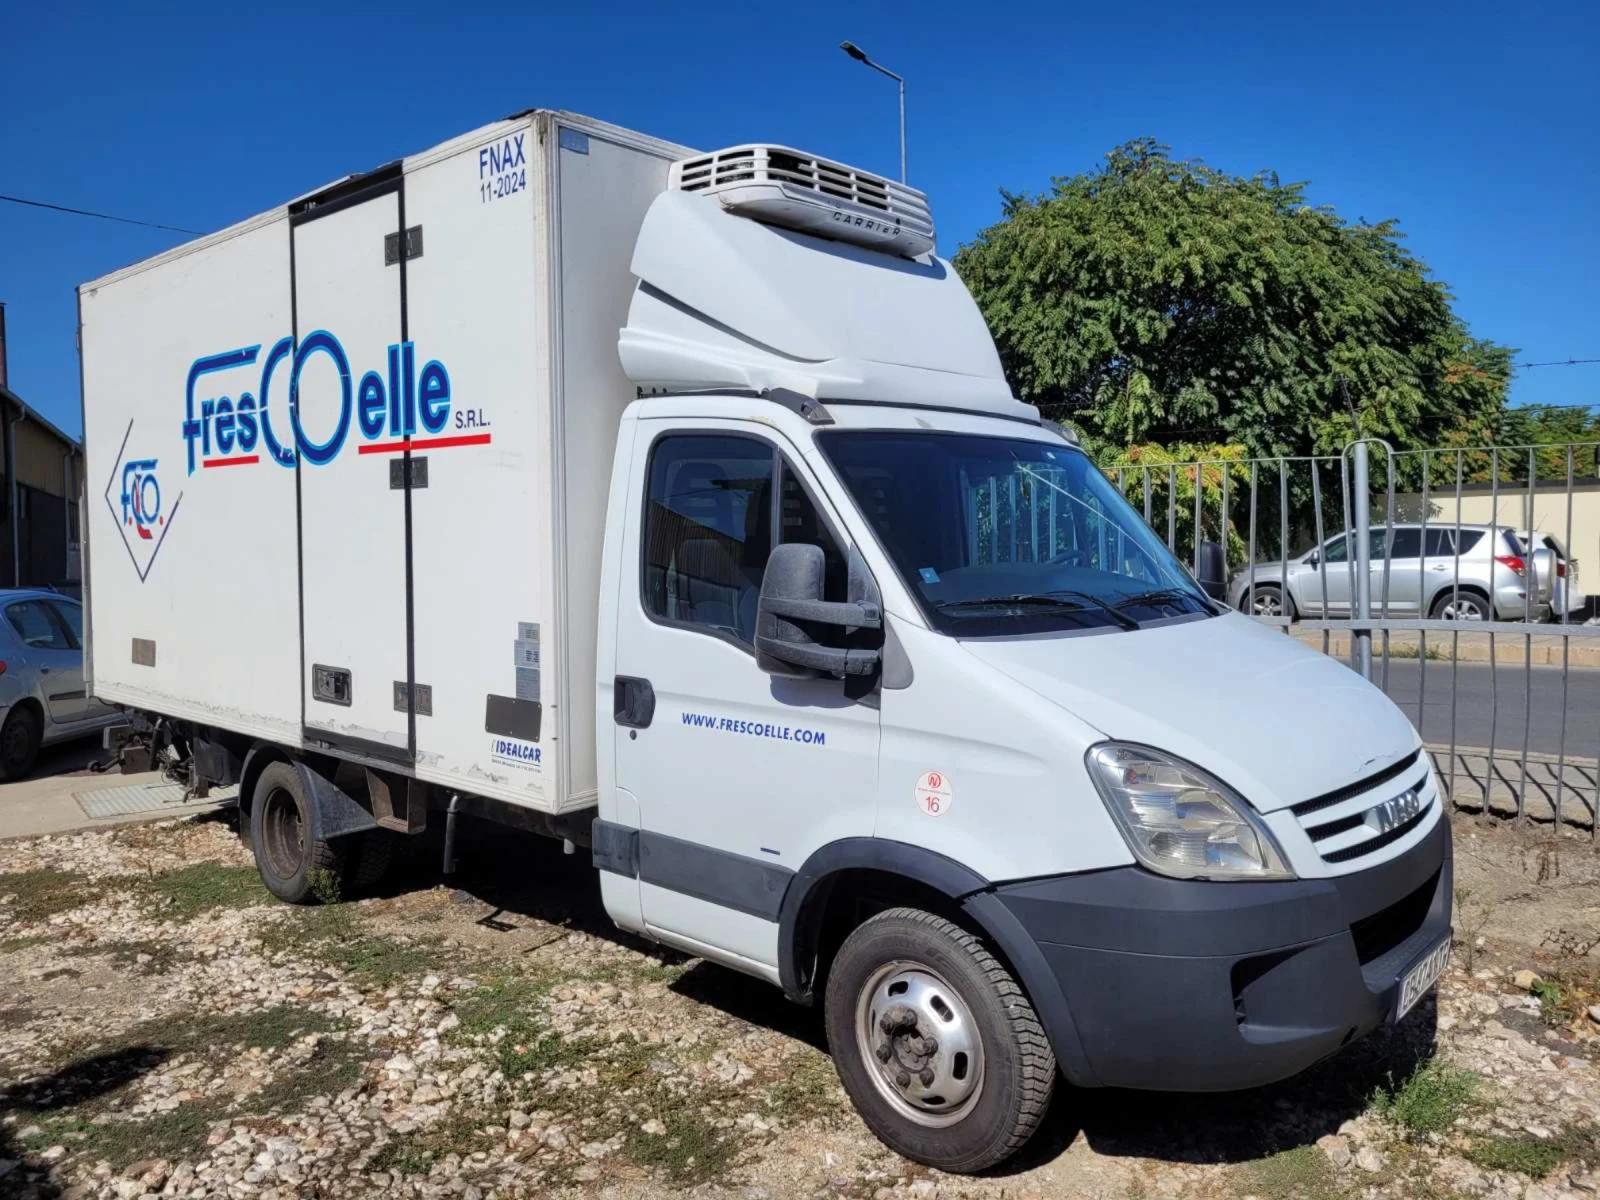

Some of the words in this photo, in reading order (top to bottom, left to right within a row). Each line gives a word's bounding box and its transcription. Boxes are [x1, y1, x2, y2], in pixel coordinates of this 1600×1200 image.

[480, 133, 525, 180] FNAX
[481, 169, 526, 203] 11-2024
[455, 408, 491, 430] S.R.L.
[682, 712, 825, 745] WWW.FRESCOELLE.COM
[495, 740, 541, 763] IDEALCAR
[926, 796, 940, 813] 16
